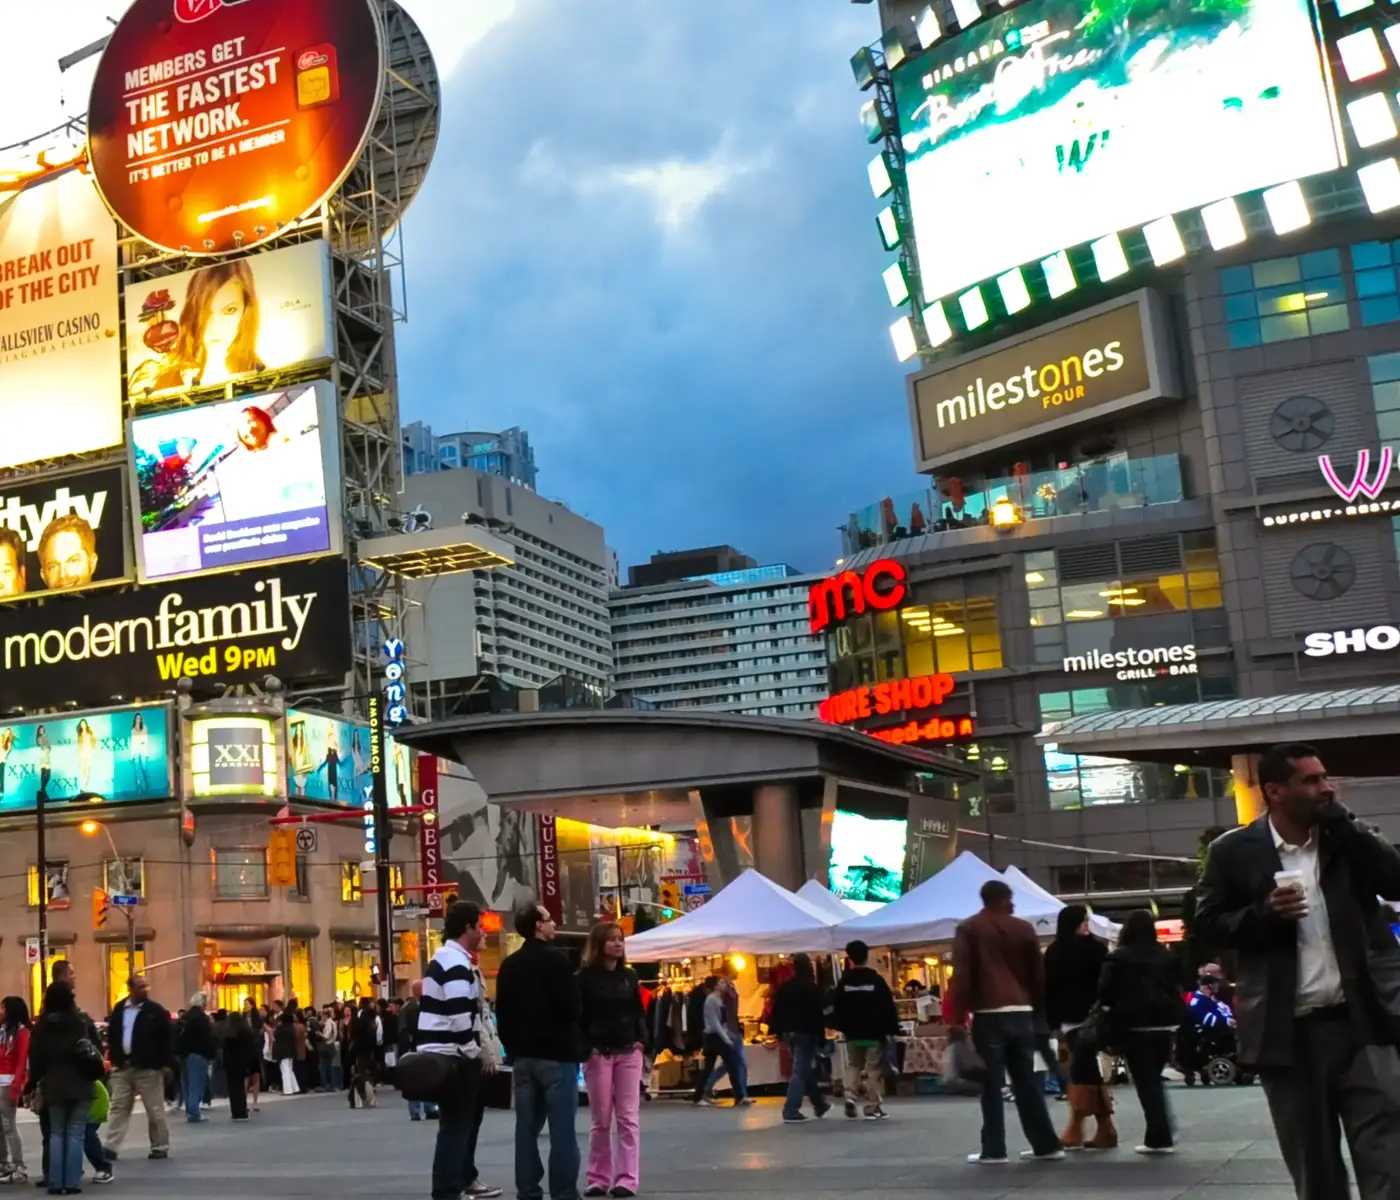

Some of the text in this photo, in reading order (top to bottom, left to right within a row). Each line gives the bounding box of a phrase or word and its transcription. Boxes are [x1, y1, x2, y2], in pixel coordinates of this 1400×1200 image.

[124, 36, 246, 91] MEMBERS GET
[921, 38, 1005, 90] NIAGARA
[125, 56, 281, 126] THE FASTEST
[126, 102, 250, 159] NETWORK.
[128, 129, 286, 185] IT'S BETTER TO BE A MEMBER
[56, 238, 95, 268] OUT
[18, 276, 54, 305] THE
[58, 264, 101, 295] CITY
[56, 312, 101, 338] CASINO
[61, 333, 101, 350] FALLS
[935, 340, 1125, 429] milestones
[1041, 384, 1086, 409] FOUR
[1263, 508, 1332, 526] BUFFET
[1063, 643, 1197, 673] milestones
[1304, 625, 1400, 657] SHO
[156, 644, 277, 681] Wed 9PM
[384, 638, 406, 724] Yong
[1116, 663, 1198, 681] GRILL BAR
[873, 672, 955, 714] SHOP
[214, 744, 260, 763] XXI
[369, 697, 380, 774] DOWNTOWN
